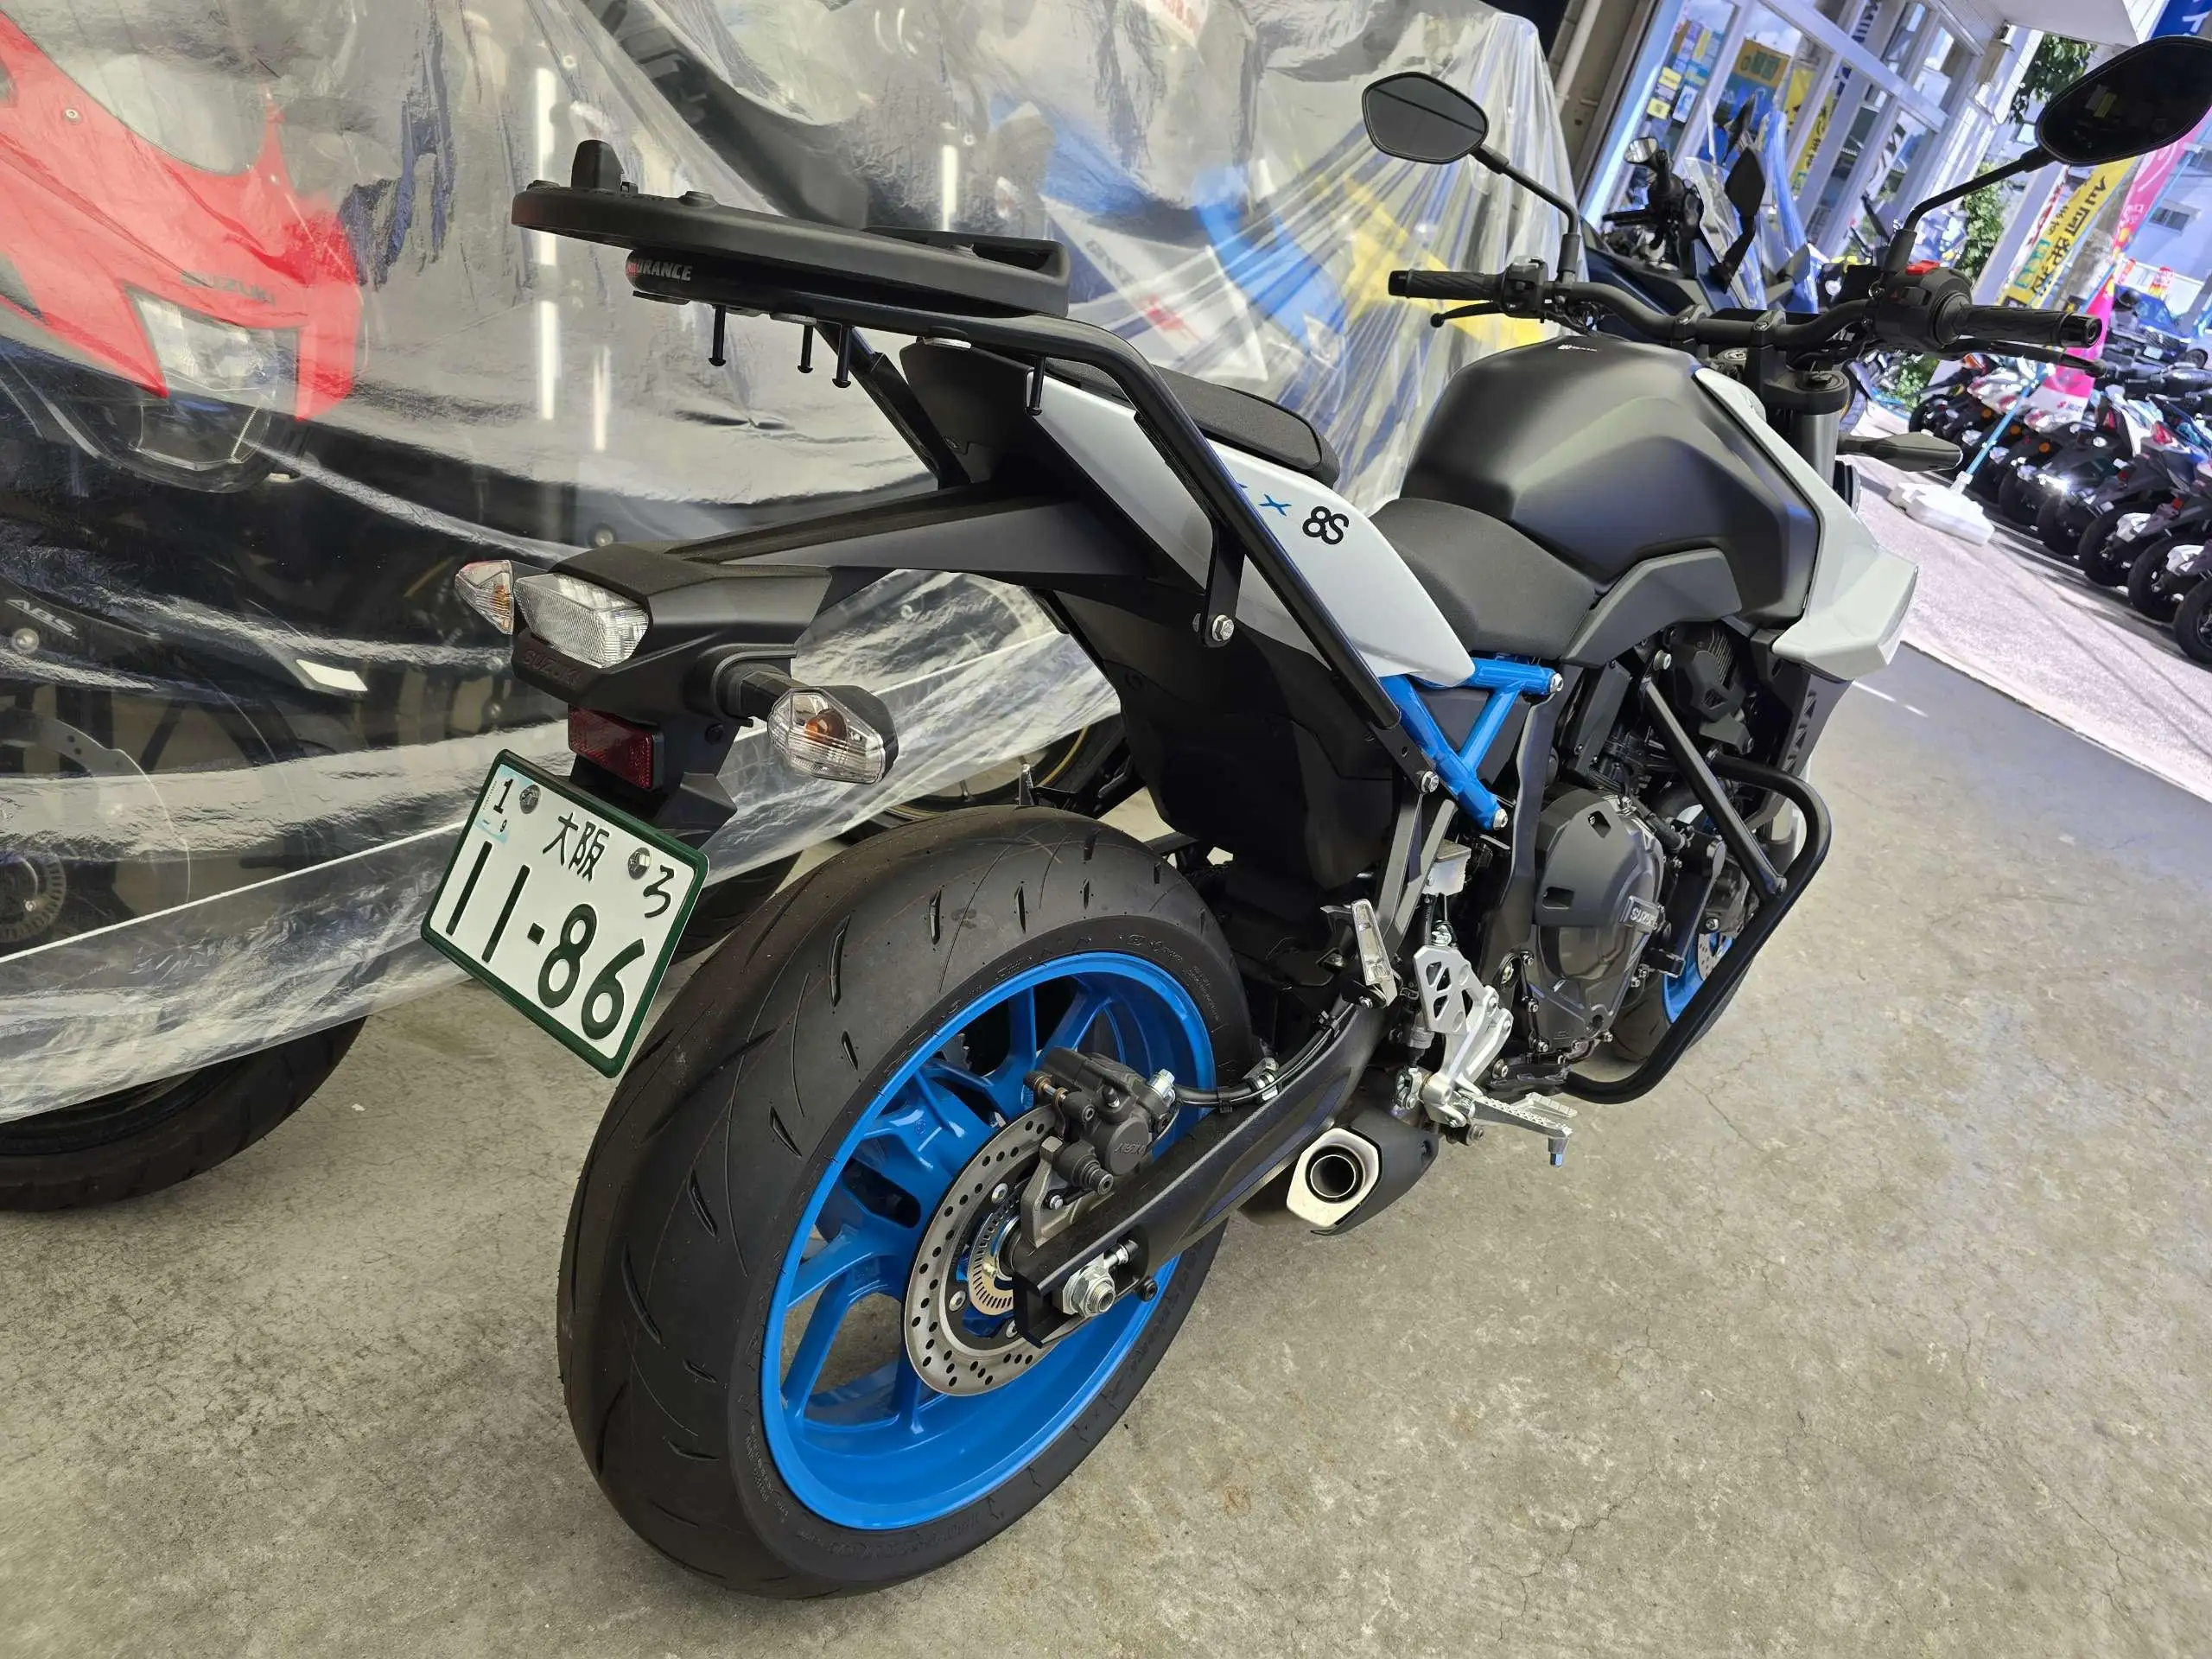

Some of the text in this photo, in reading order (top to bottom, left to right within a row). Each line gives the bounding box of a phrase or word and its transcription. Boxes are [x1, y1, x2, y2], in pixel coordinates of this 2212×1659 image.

[1302, 505, 1350, 544] 8S
[6, 599, 77, 638] ABS
[493, 779, 514, 814] 1
[543, 812, 609, 881] 大阪
